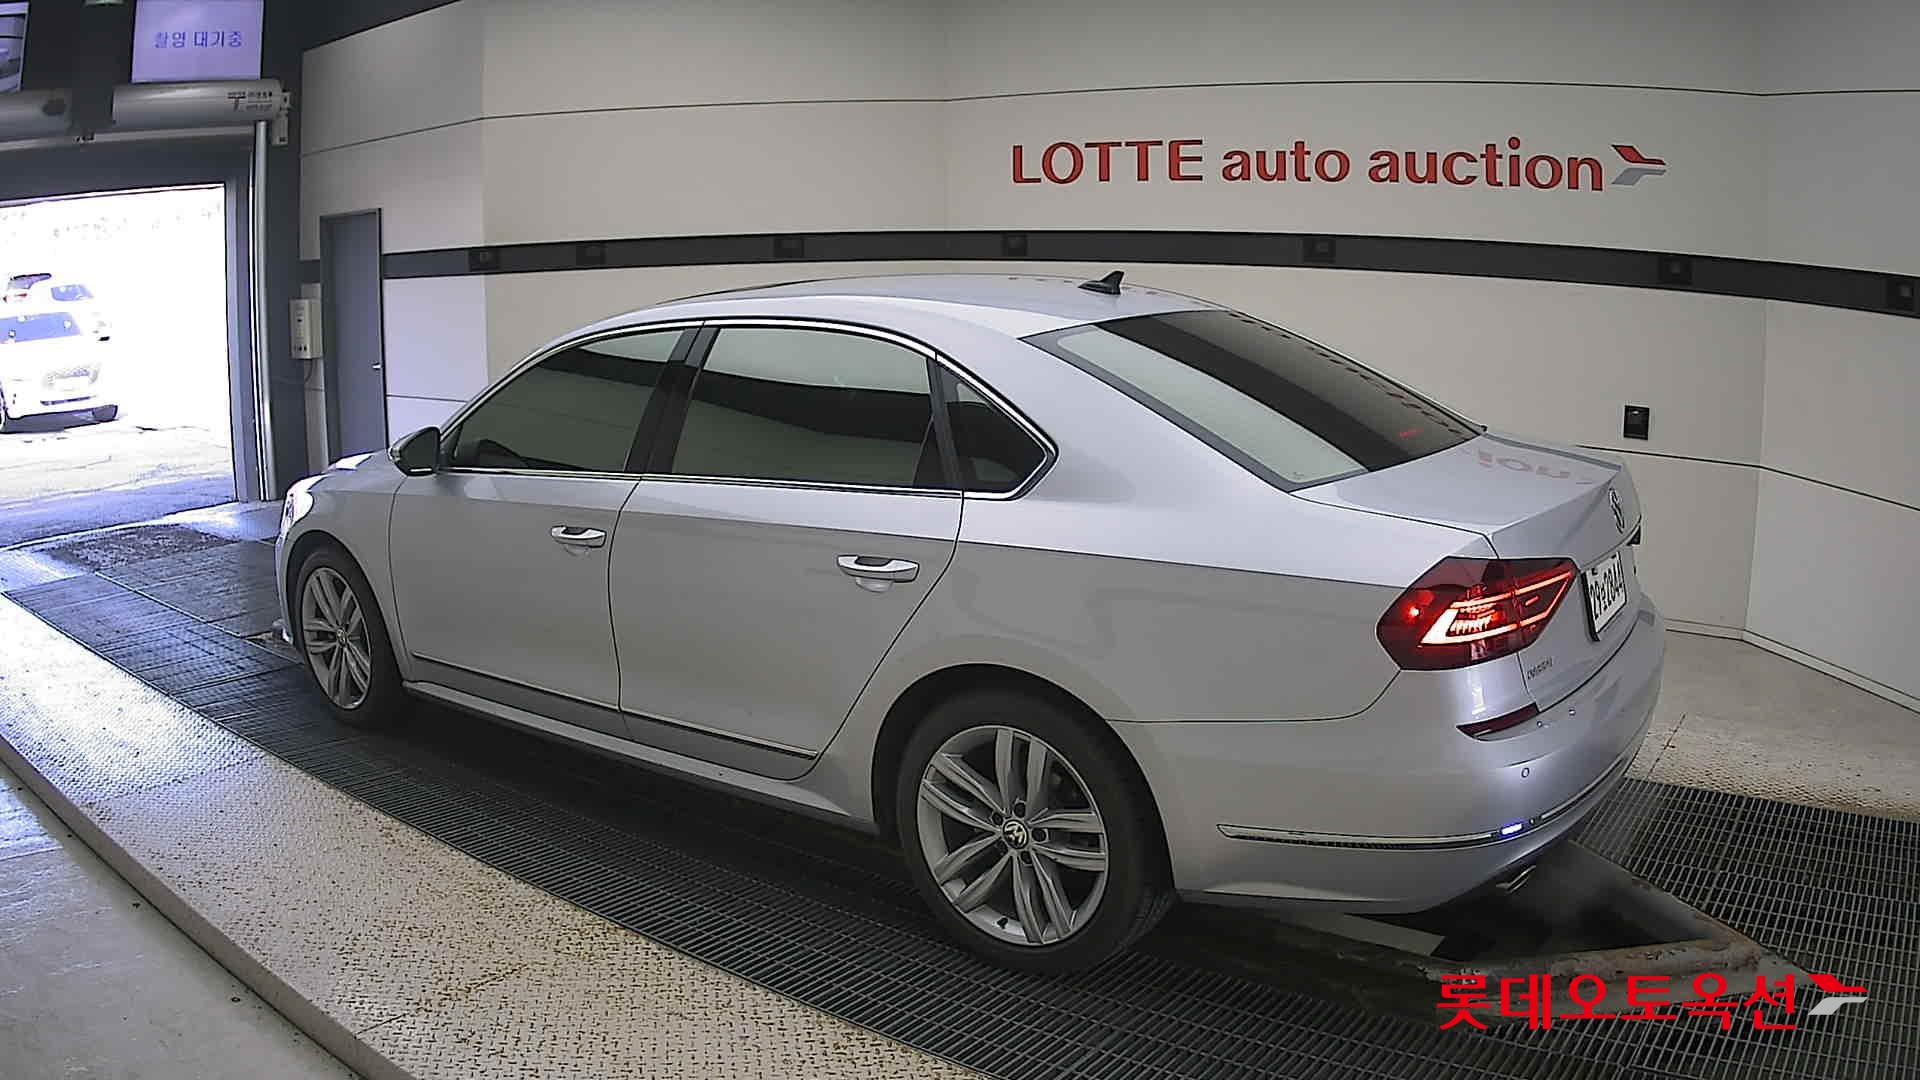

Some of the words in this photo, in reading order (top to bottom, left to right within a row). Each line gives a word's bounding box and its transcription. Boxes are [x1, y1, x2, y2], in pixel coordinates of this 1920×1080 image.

[193, 30, 242, 48] 대기중
[1012, 139, 1203, 184] LOTTE
[1221, 140, 1351, 183] auto
[1367, 137, 1603, 191] auction
